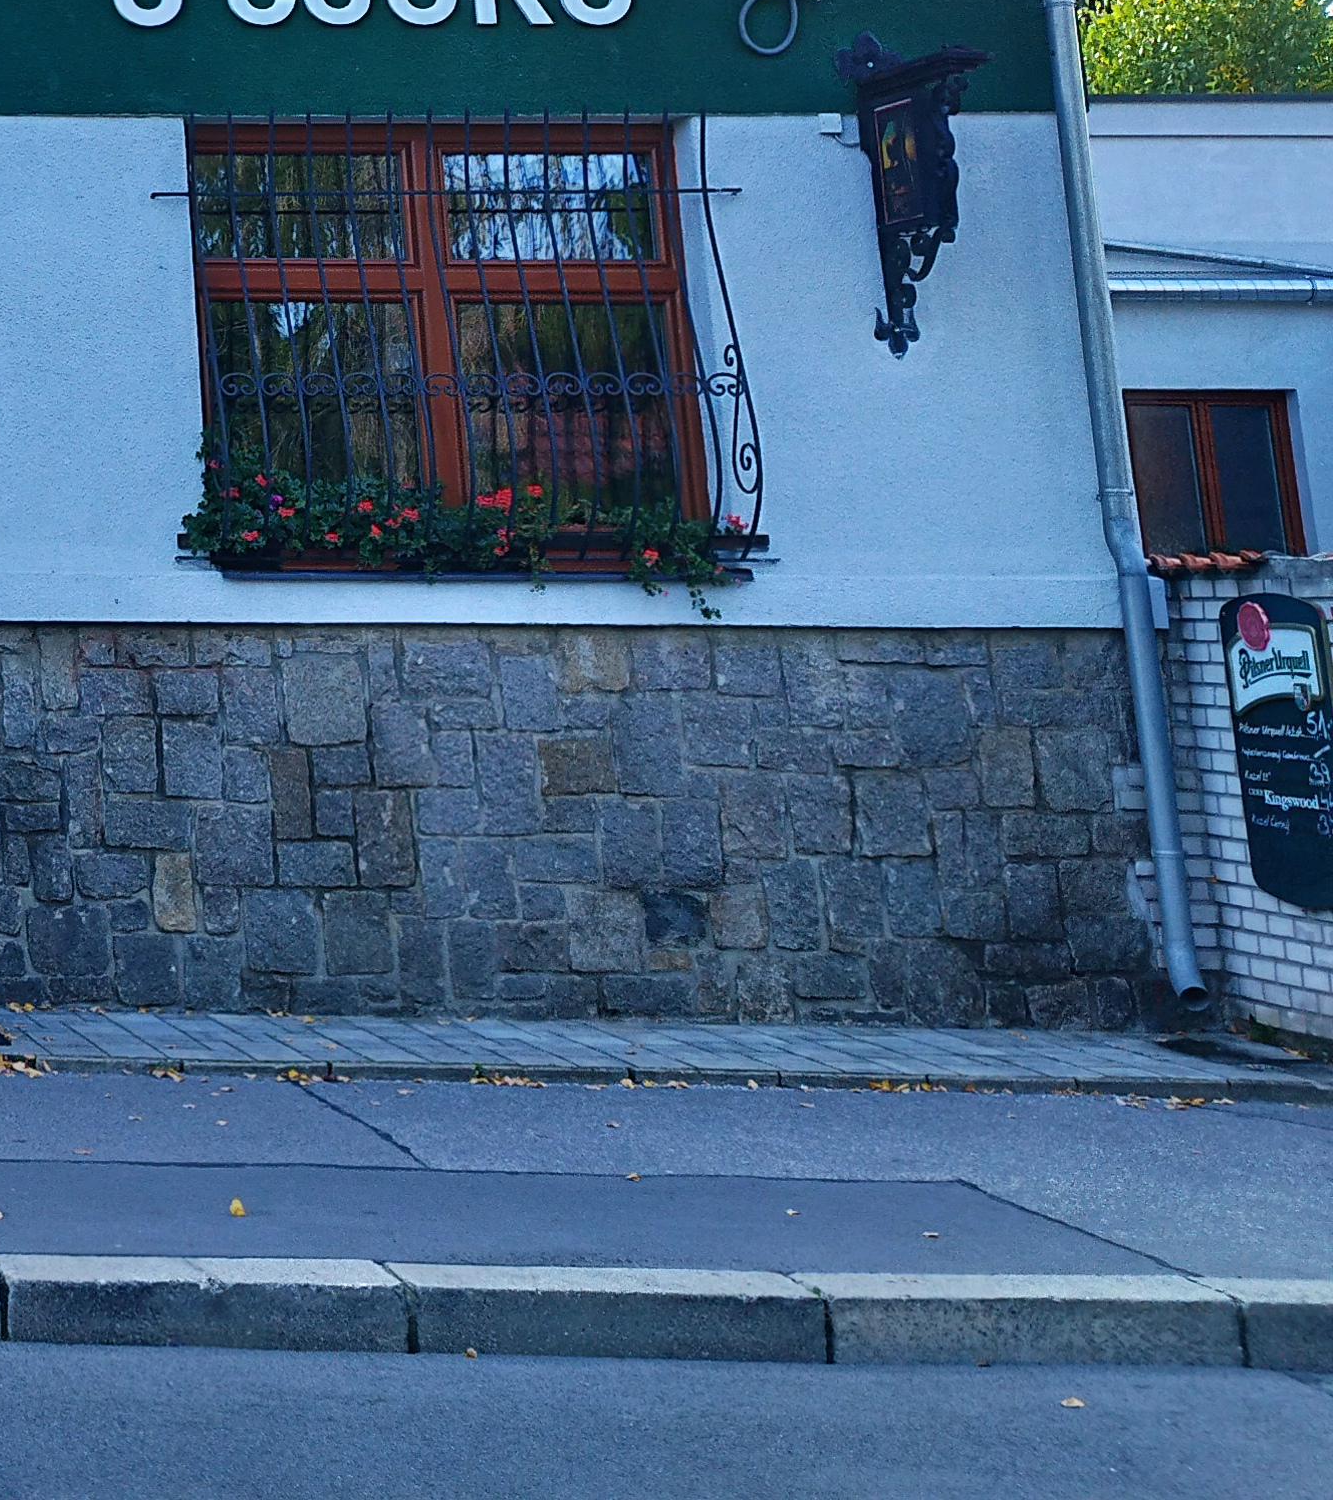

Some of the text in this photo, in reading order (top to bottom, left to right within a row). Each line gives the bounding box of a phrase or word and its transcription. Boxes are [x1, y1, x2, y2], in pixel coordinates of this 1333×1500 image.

[1239, 647, 1310, 689] Pilsner Urquell
[1263, 789, 1320, 811] Kingswood
